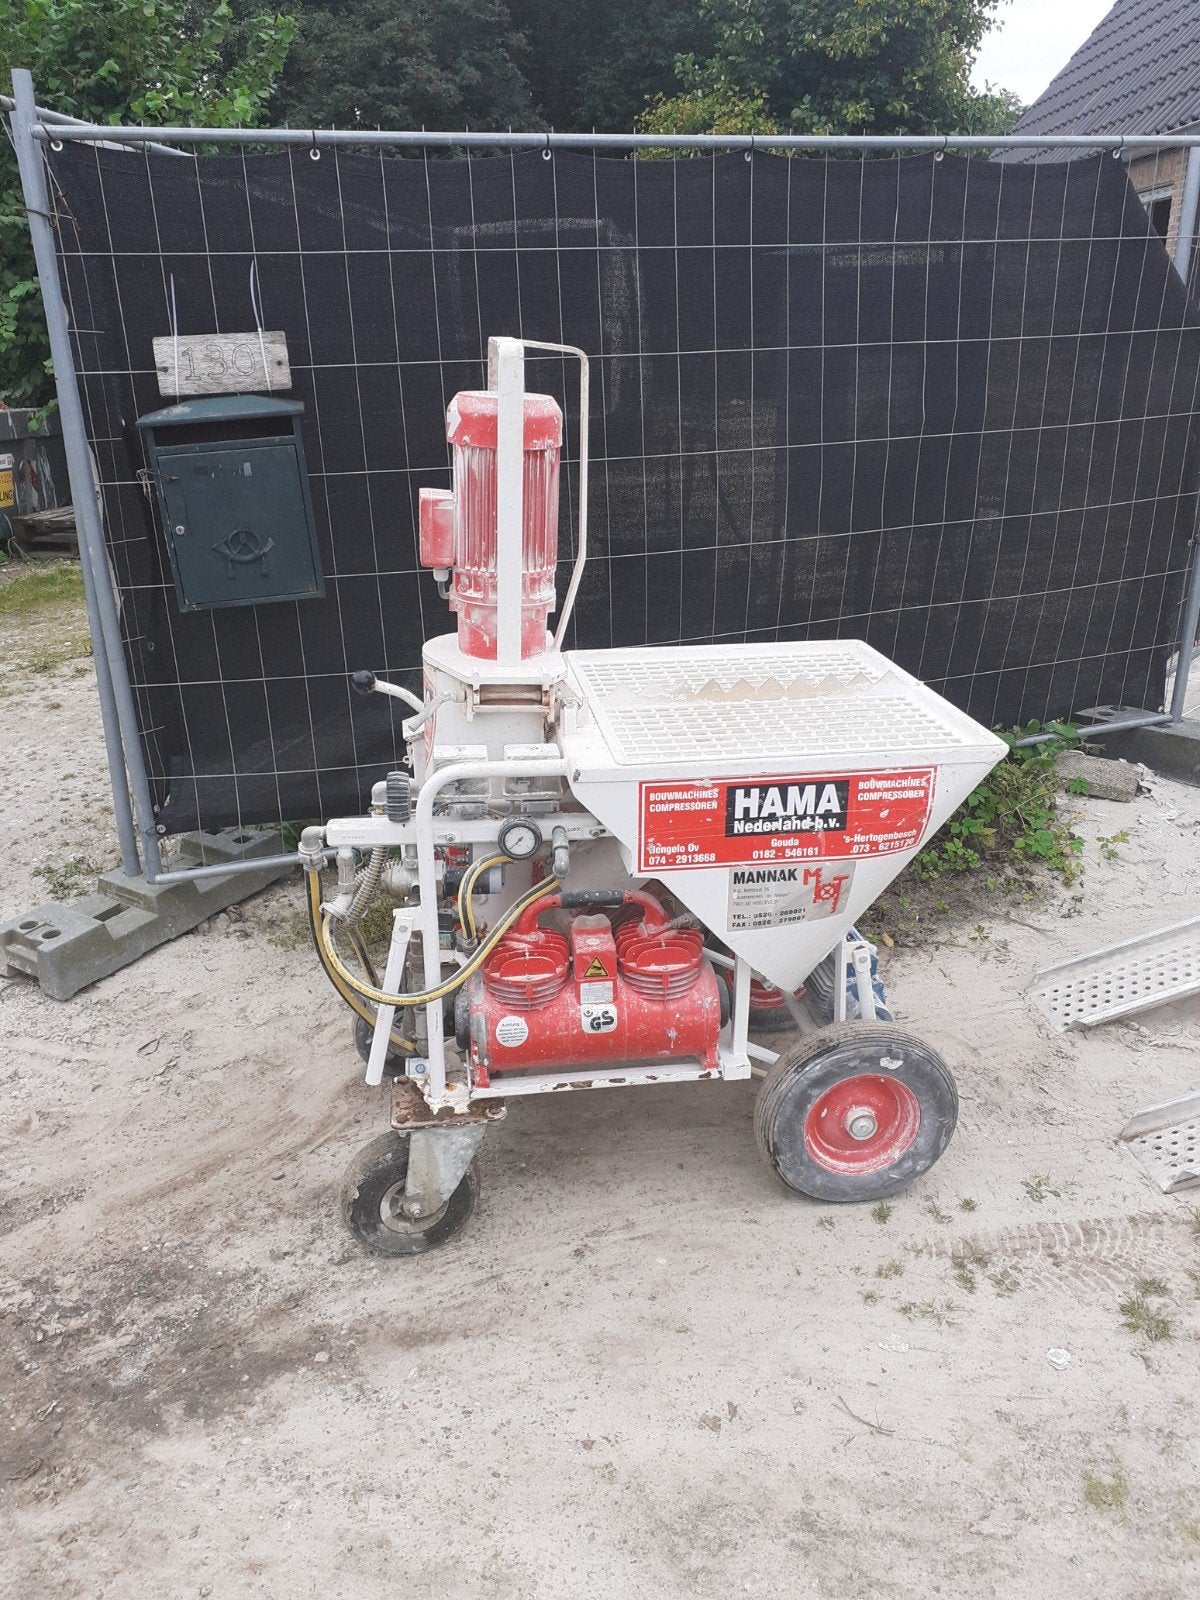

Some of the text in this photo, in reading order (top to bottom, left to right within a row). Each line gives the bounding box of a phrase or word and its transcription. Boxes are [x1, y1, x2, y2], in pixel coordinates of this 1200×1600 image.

[182, 344, 255, 380] 130
[858, 778, 926, 790] BOUWMACHINES
[649, 789, 718, 802] BOUWMACHINES
[857, 790, 925, 801] COMPRESSOREN
[650, 801, 718, 812] COMPRESSOREN
[735, 784, 841, 819] HAMA
[843, 829, 917, 844] 's-Hertogenbosch
[688, 843, 699, 852] Ov
[771, 838, 799, 847] Gouda
[752, 850, 776, 859] 0182
[852, 844, 870, 854] 073
[649, 856, 666, 865] 074
[733, 868, 798, 884] MANNAK
[590, 1010, 615, 1031] GS
